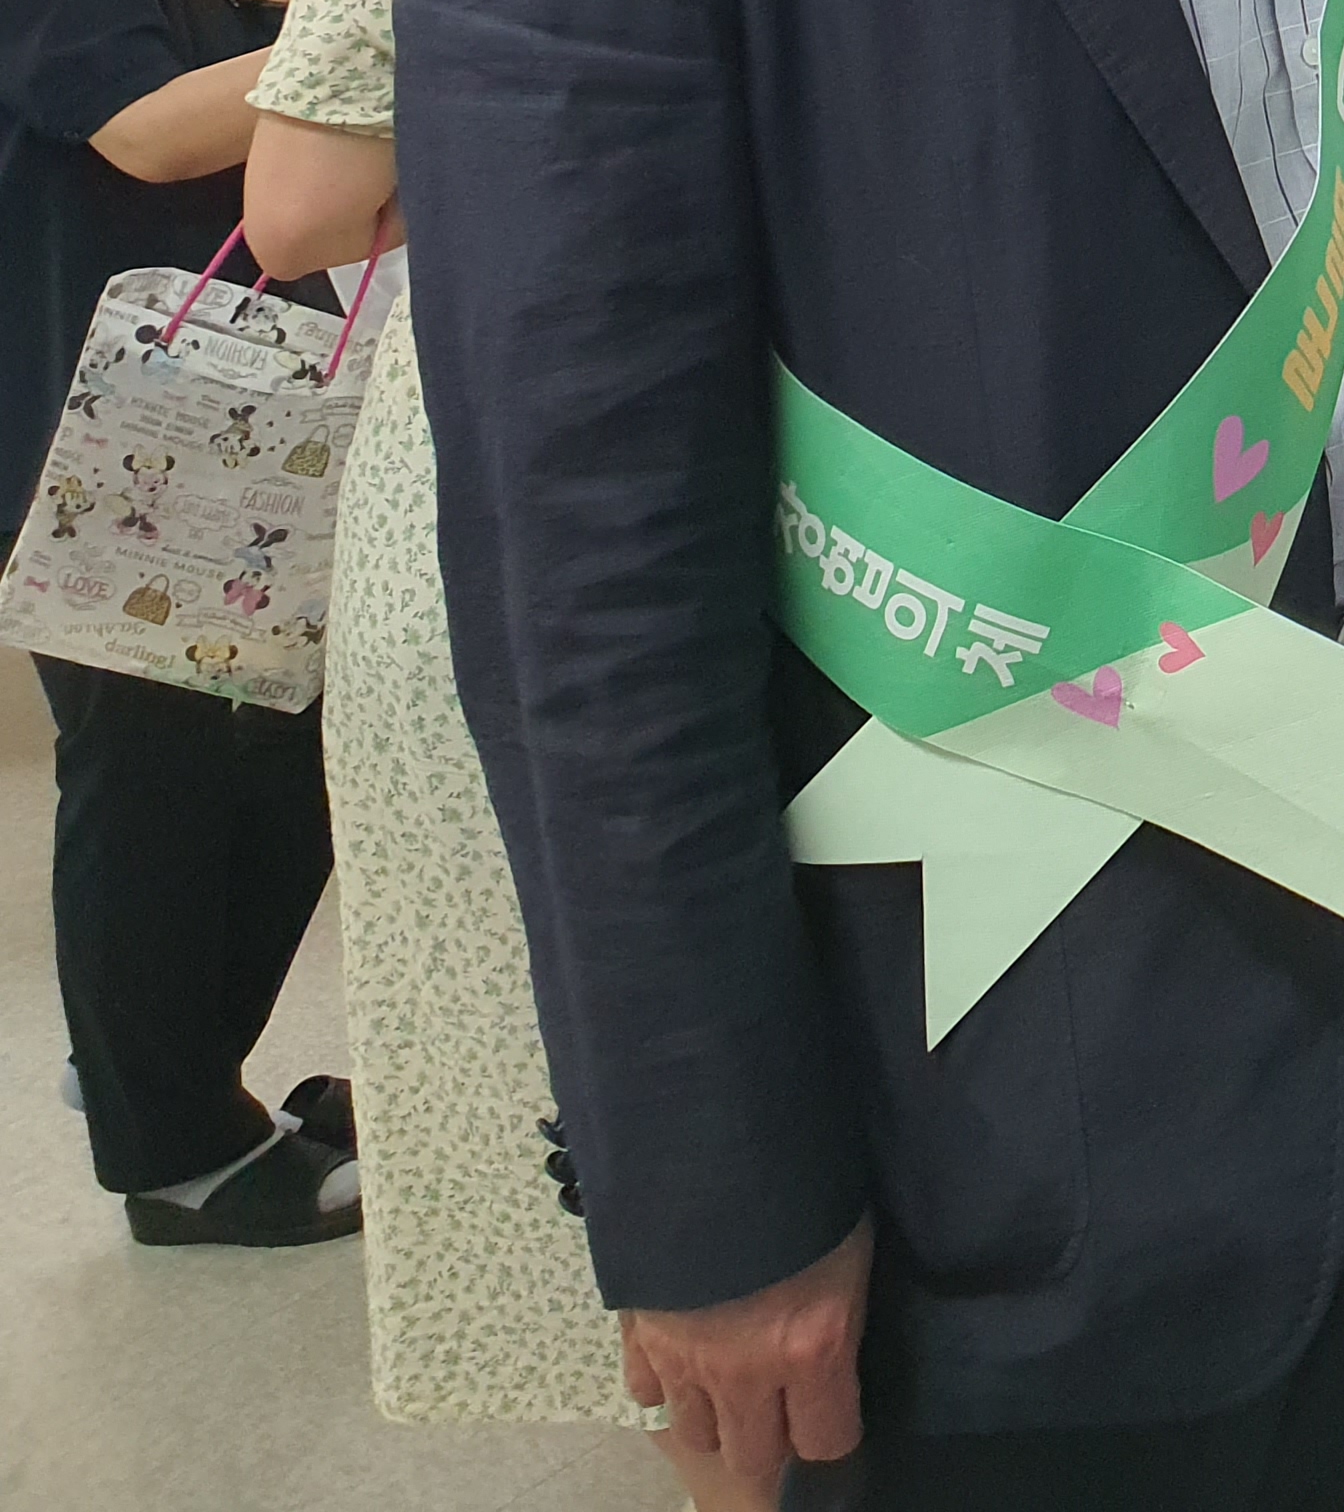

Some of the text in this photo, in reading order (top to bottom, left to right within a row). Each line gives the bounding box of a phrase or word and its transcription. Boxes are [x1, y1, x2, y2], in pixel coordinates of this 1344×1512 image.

[240, 487, 306, 516] FASHION
[115, 546, 227, 581] MINNIE MOUSE
[62, 573, 110, 601] LOVE
